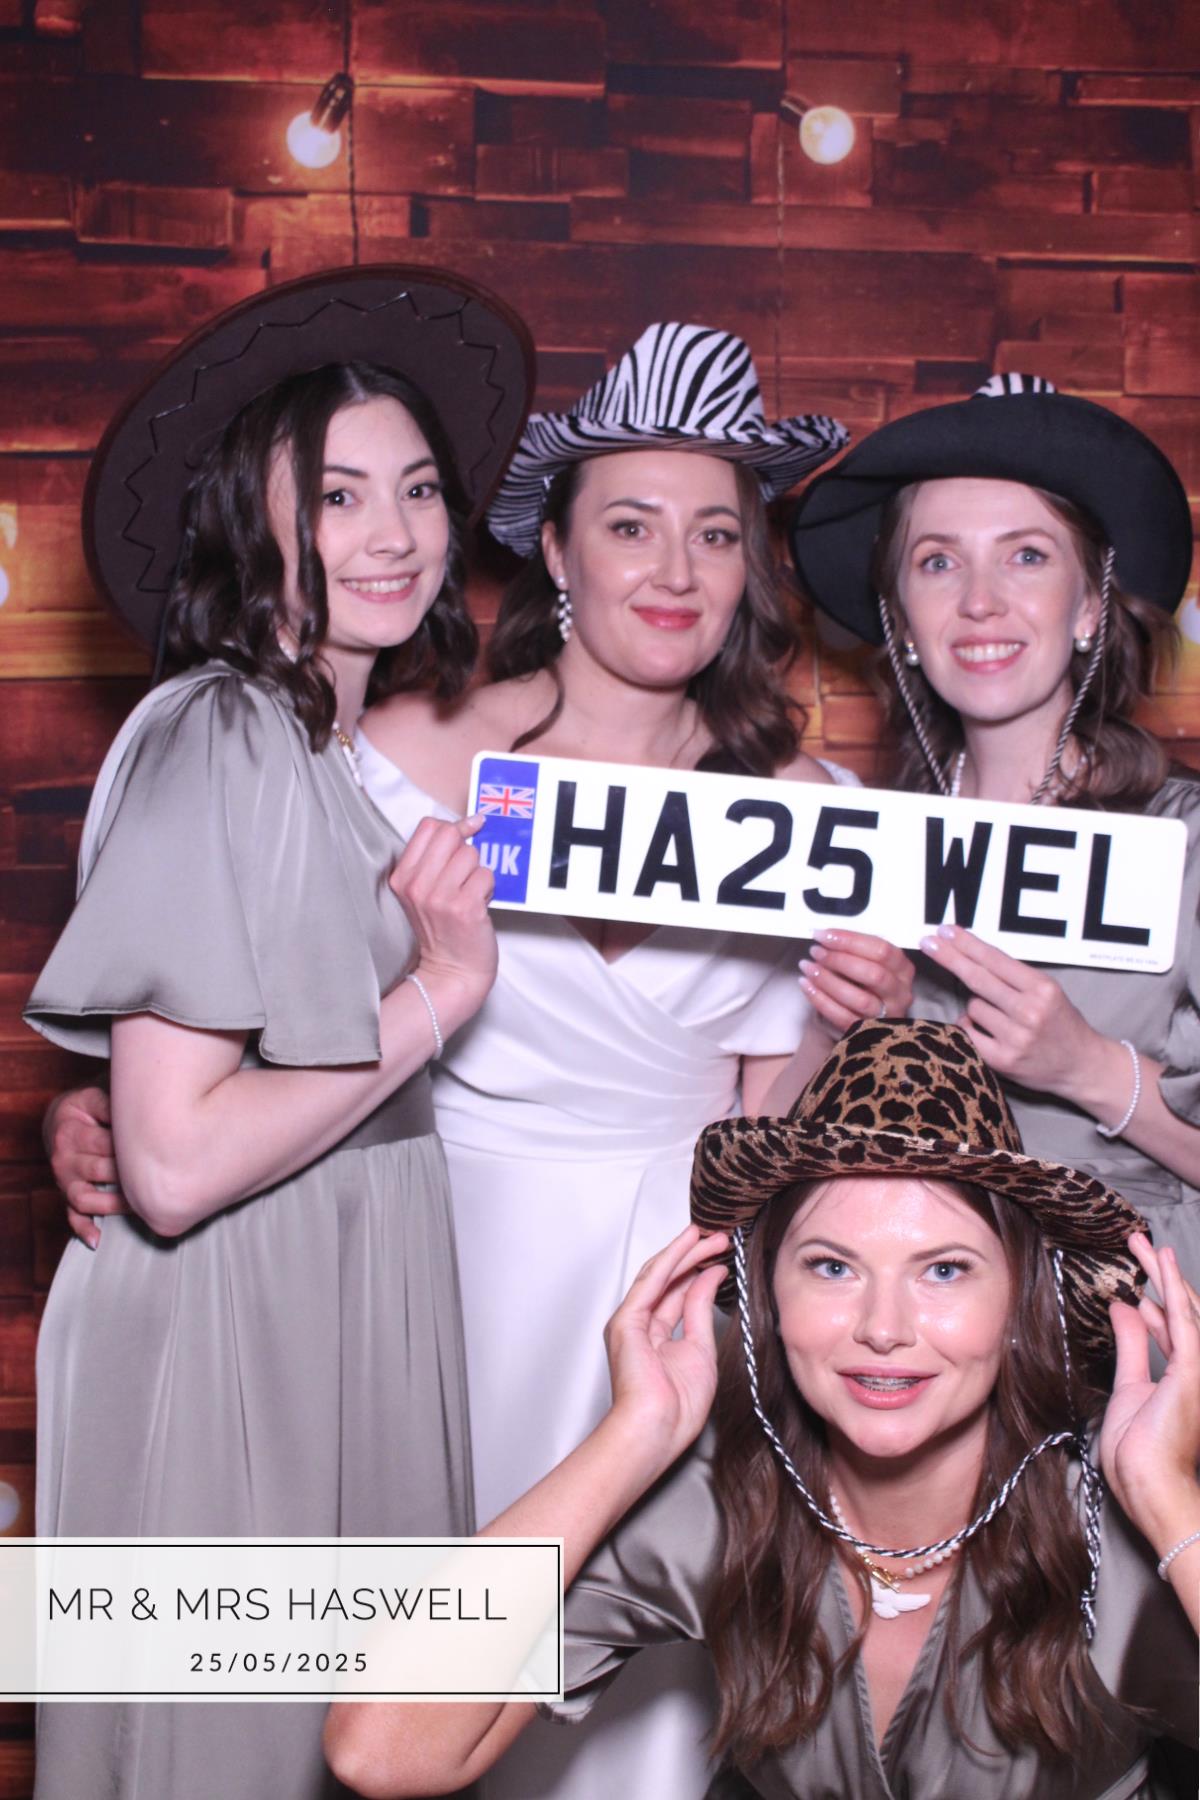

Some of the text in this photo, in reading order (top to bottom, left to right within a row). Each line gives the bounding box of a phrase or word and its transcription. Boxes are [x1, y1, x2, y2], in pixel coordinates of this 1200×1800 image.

[479, 842, 522, 876] UK
[549, 781, 1150, 946] HA25 WEL
